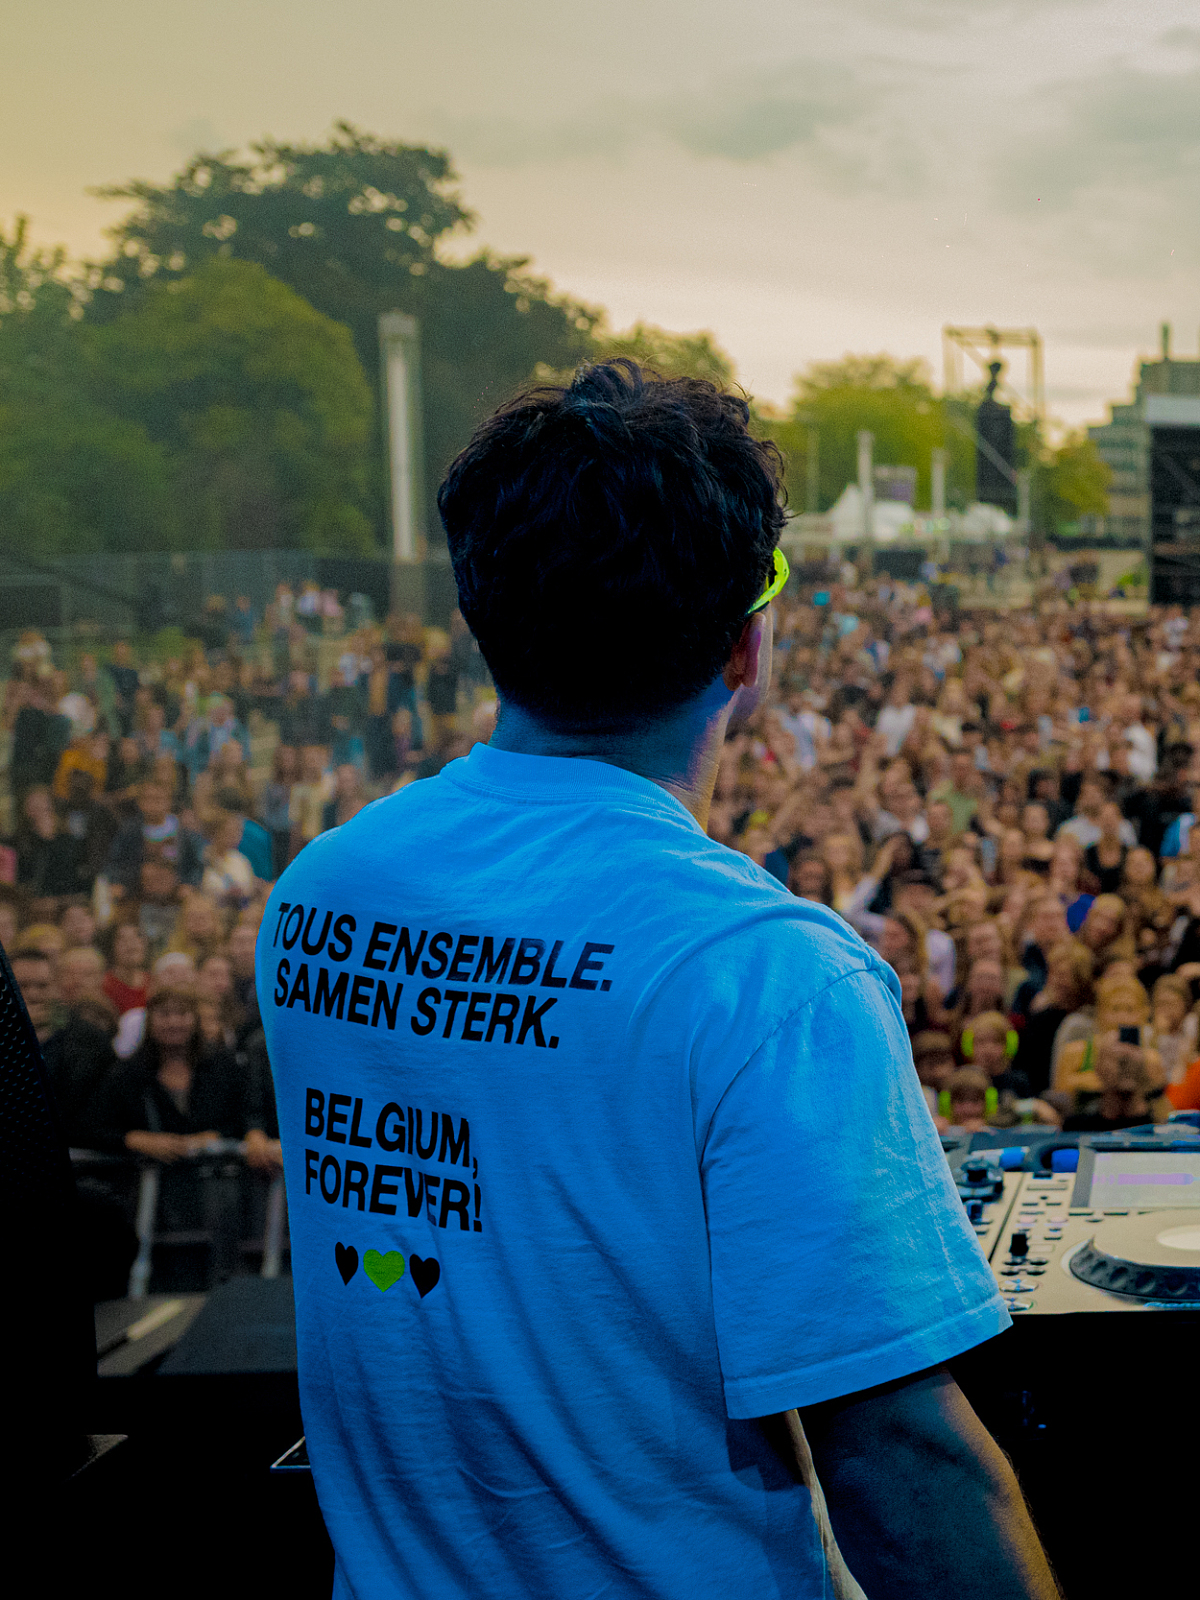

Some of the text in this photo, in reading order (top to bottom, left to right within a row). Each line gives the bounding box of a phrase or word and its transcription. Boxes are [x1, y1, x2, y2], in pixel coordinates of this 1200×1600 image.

[272, 902, 616, 992] TOUS ENSEMBLE.
[273, 957, 560, 1049] SAMEN STERK.
[304, 1087, 479, 1180] BELGIUM,
[304, 1148, 484, 1233] FOREVER!
